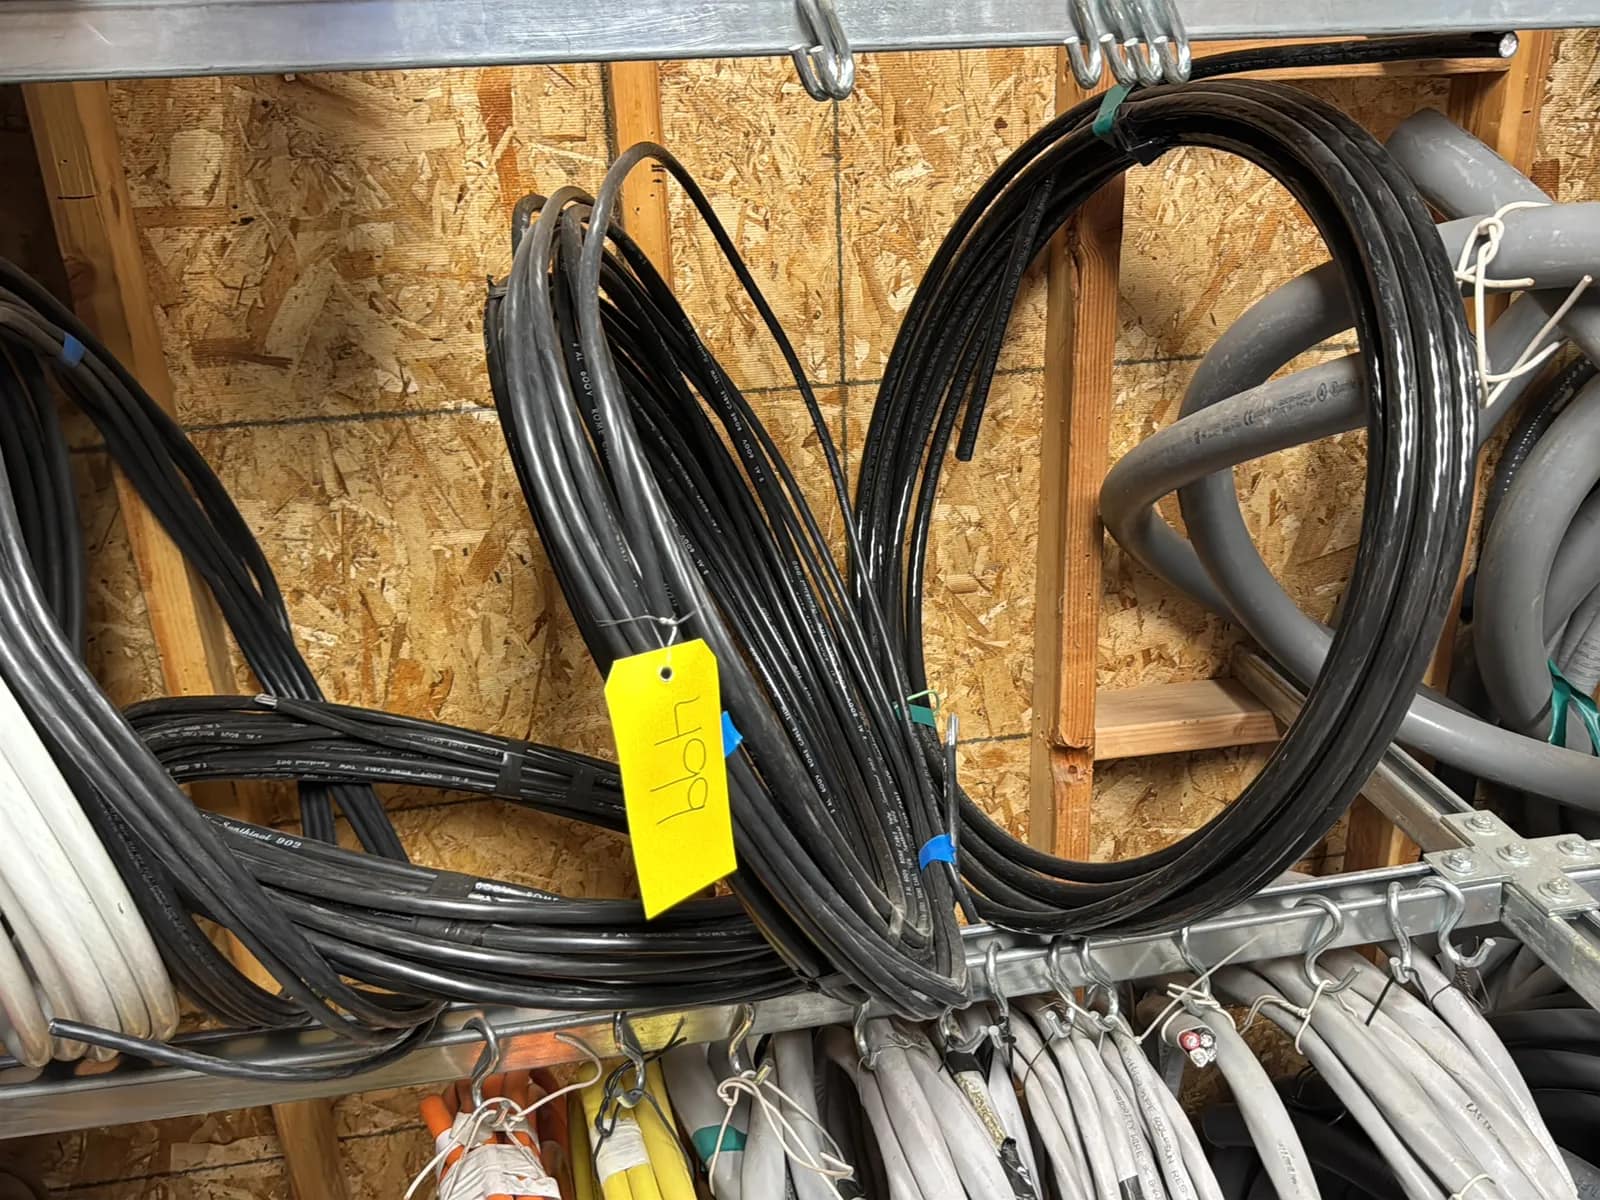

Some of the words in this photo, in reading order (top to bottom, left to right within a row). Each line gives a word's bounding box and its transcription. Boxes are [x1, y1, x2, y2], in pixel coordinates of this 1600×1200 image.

[580, 371, 592, 396] 600V
[742, 439, 754, 459] 600V
[680, 533, 696, 554] 600V
[650, 695, 708, 826] 499
[803, 749, 814, 768] ROME
[814, 774, 826, 793] 600V
[275, 835, 305, 850] 902
